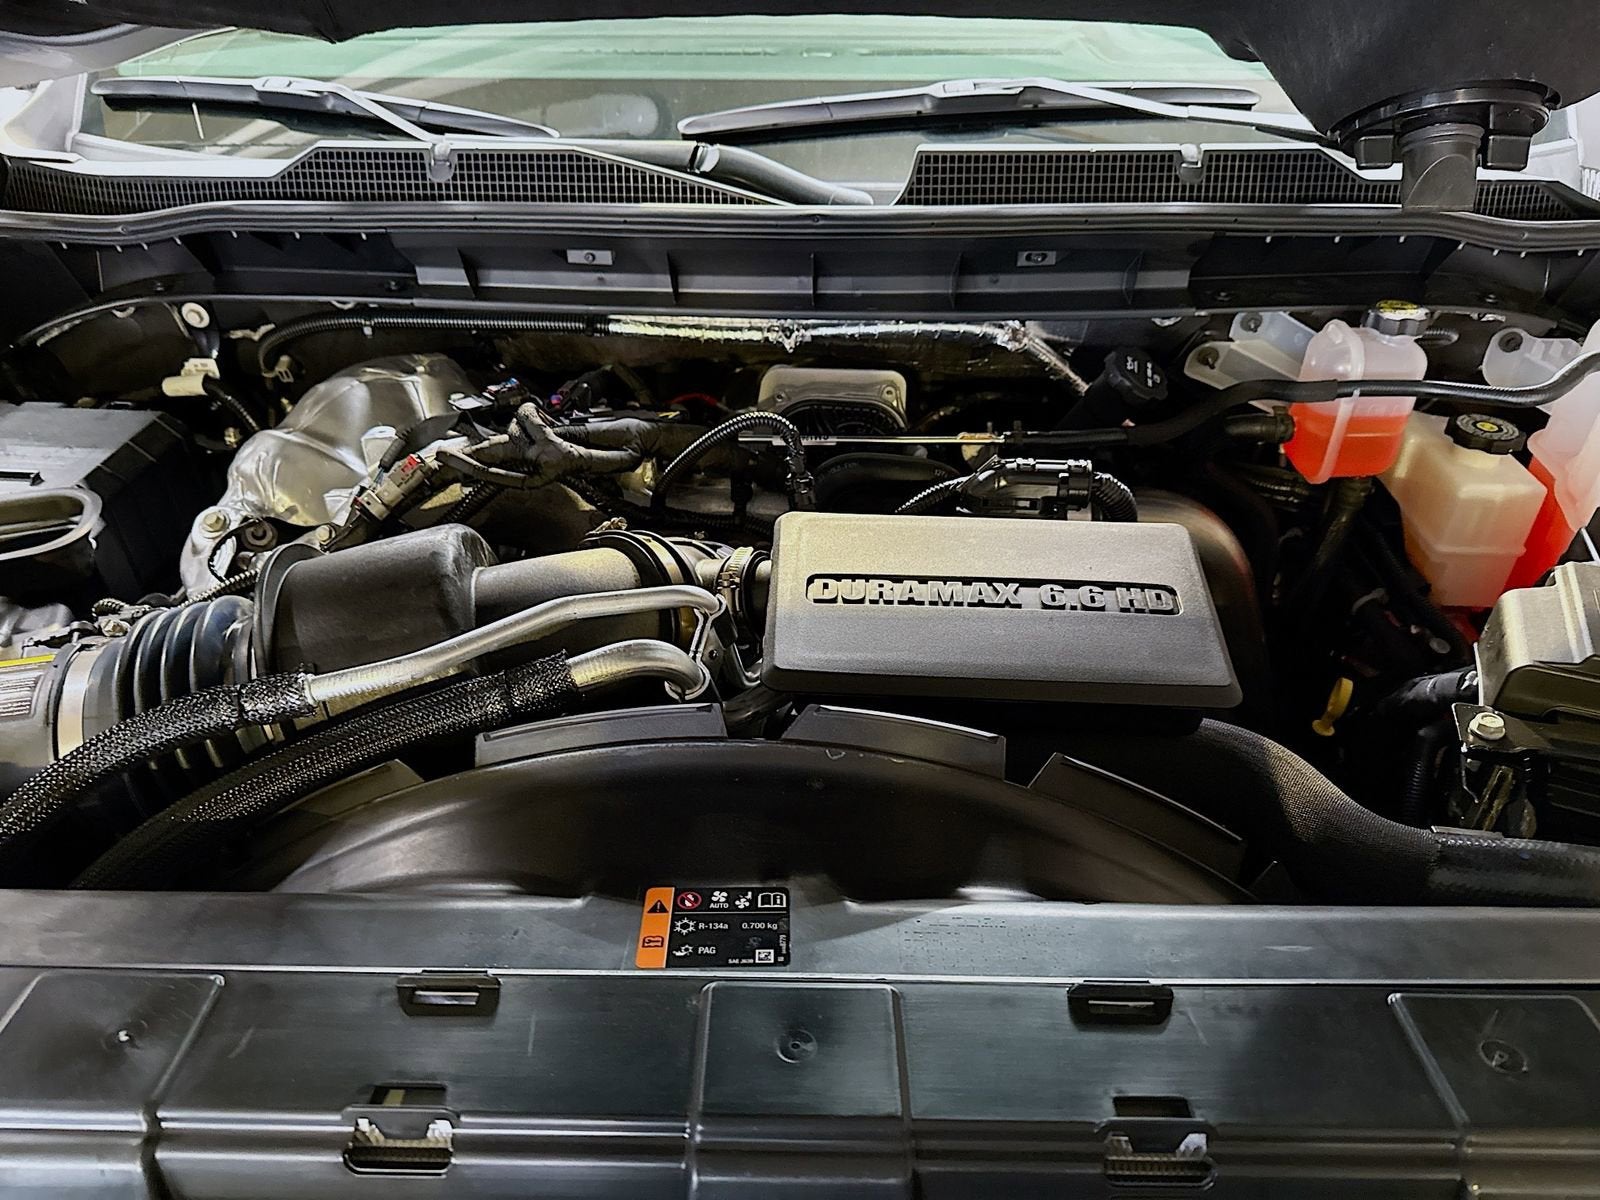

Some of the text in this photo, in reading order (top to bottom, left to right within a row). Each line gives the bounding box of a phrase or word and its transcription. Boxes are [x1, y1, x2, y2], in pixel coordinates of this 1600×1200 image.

[813, 577, 1176, 615] DURAMAX 6.6 HD
[767, 922, 778, 931] kg
